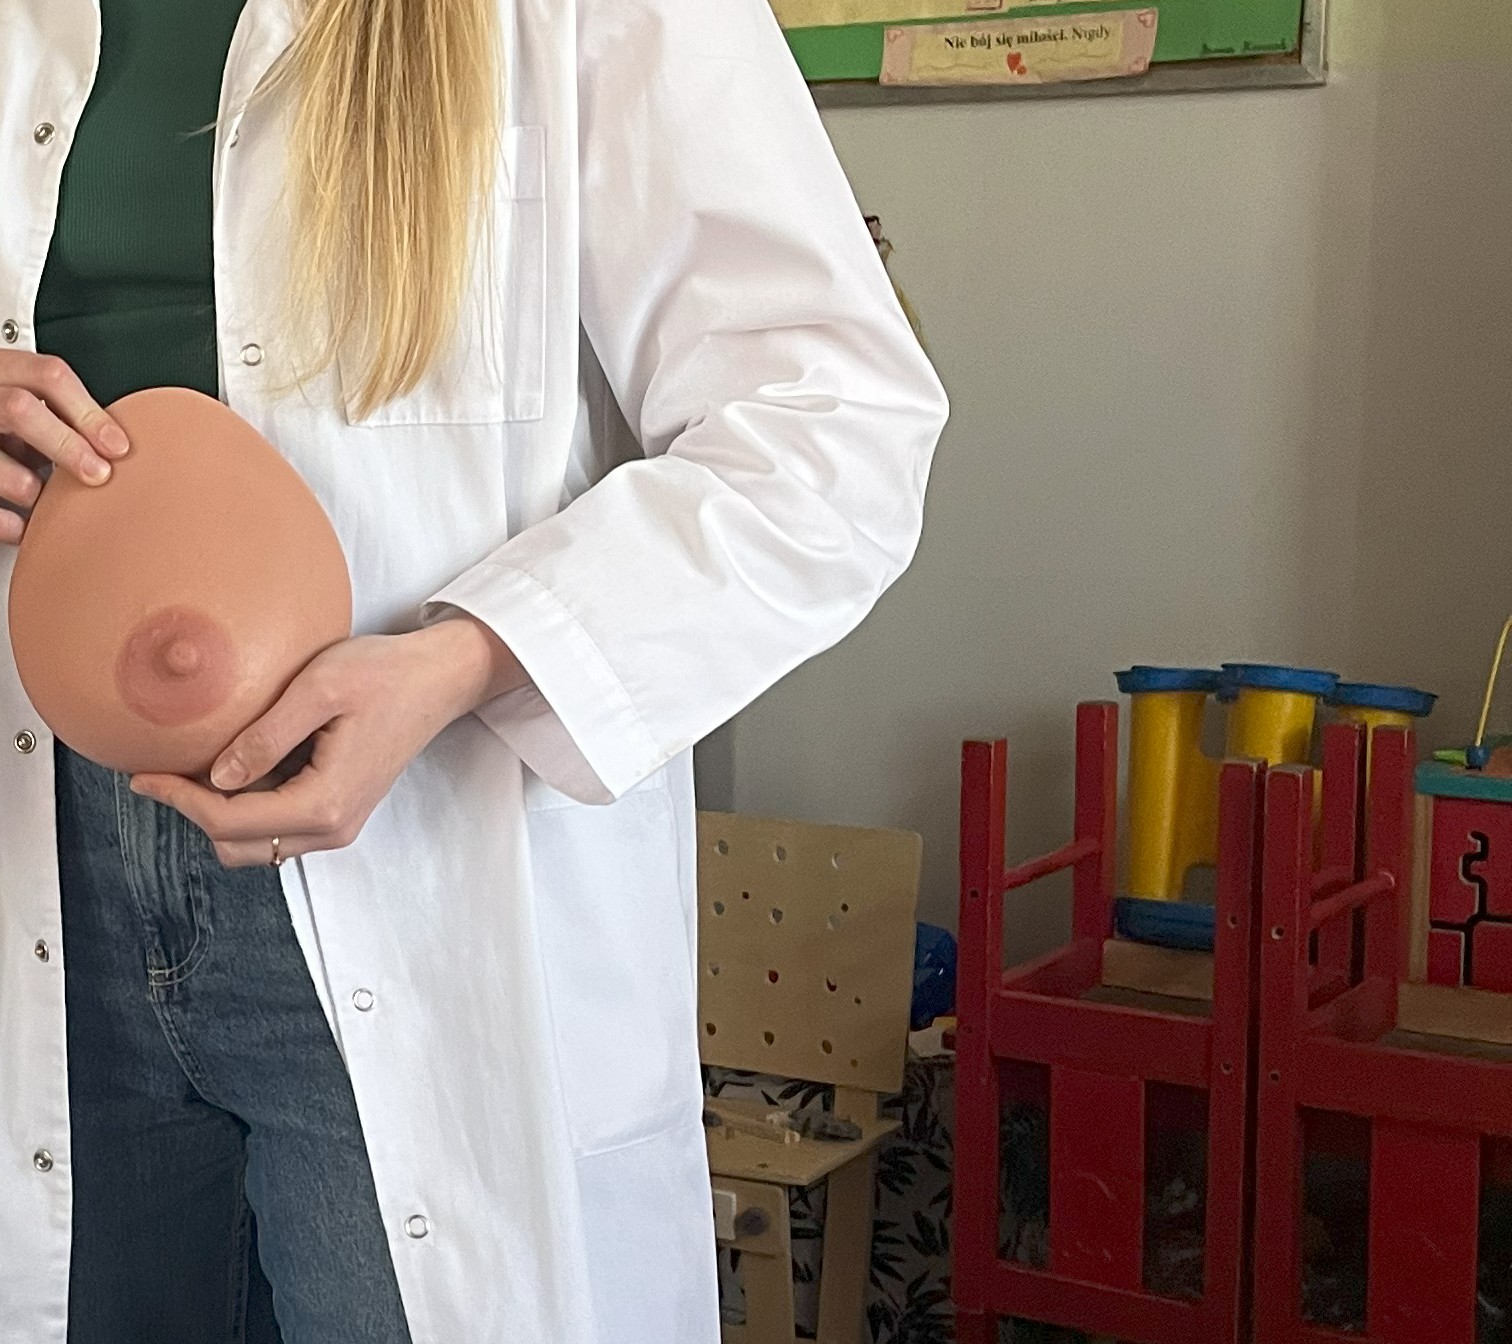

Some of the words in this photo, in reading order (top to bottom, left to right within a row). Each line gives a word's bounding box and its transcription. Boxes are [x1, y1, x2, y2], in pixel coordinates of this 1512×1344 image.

[944, 36, 966, 49] Nie
[970, 33, 991, 49] bój
[996, 33, 1013, 48] się
[1017, 28, 1067, 44] miłości.
[1072, 24, 1110, 41] Nigdy
